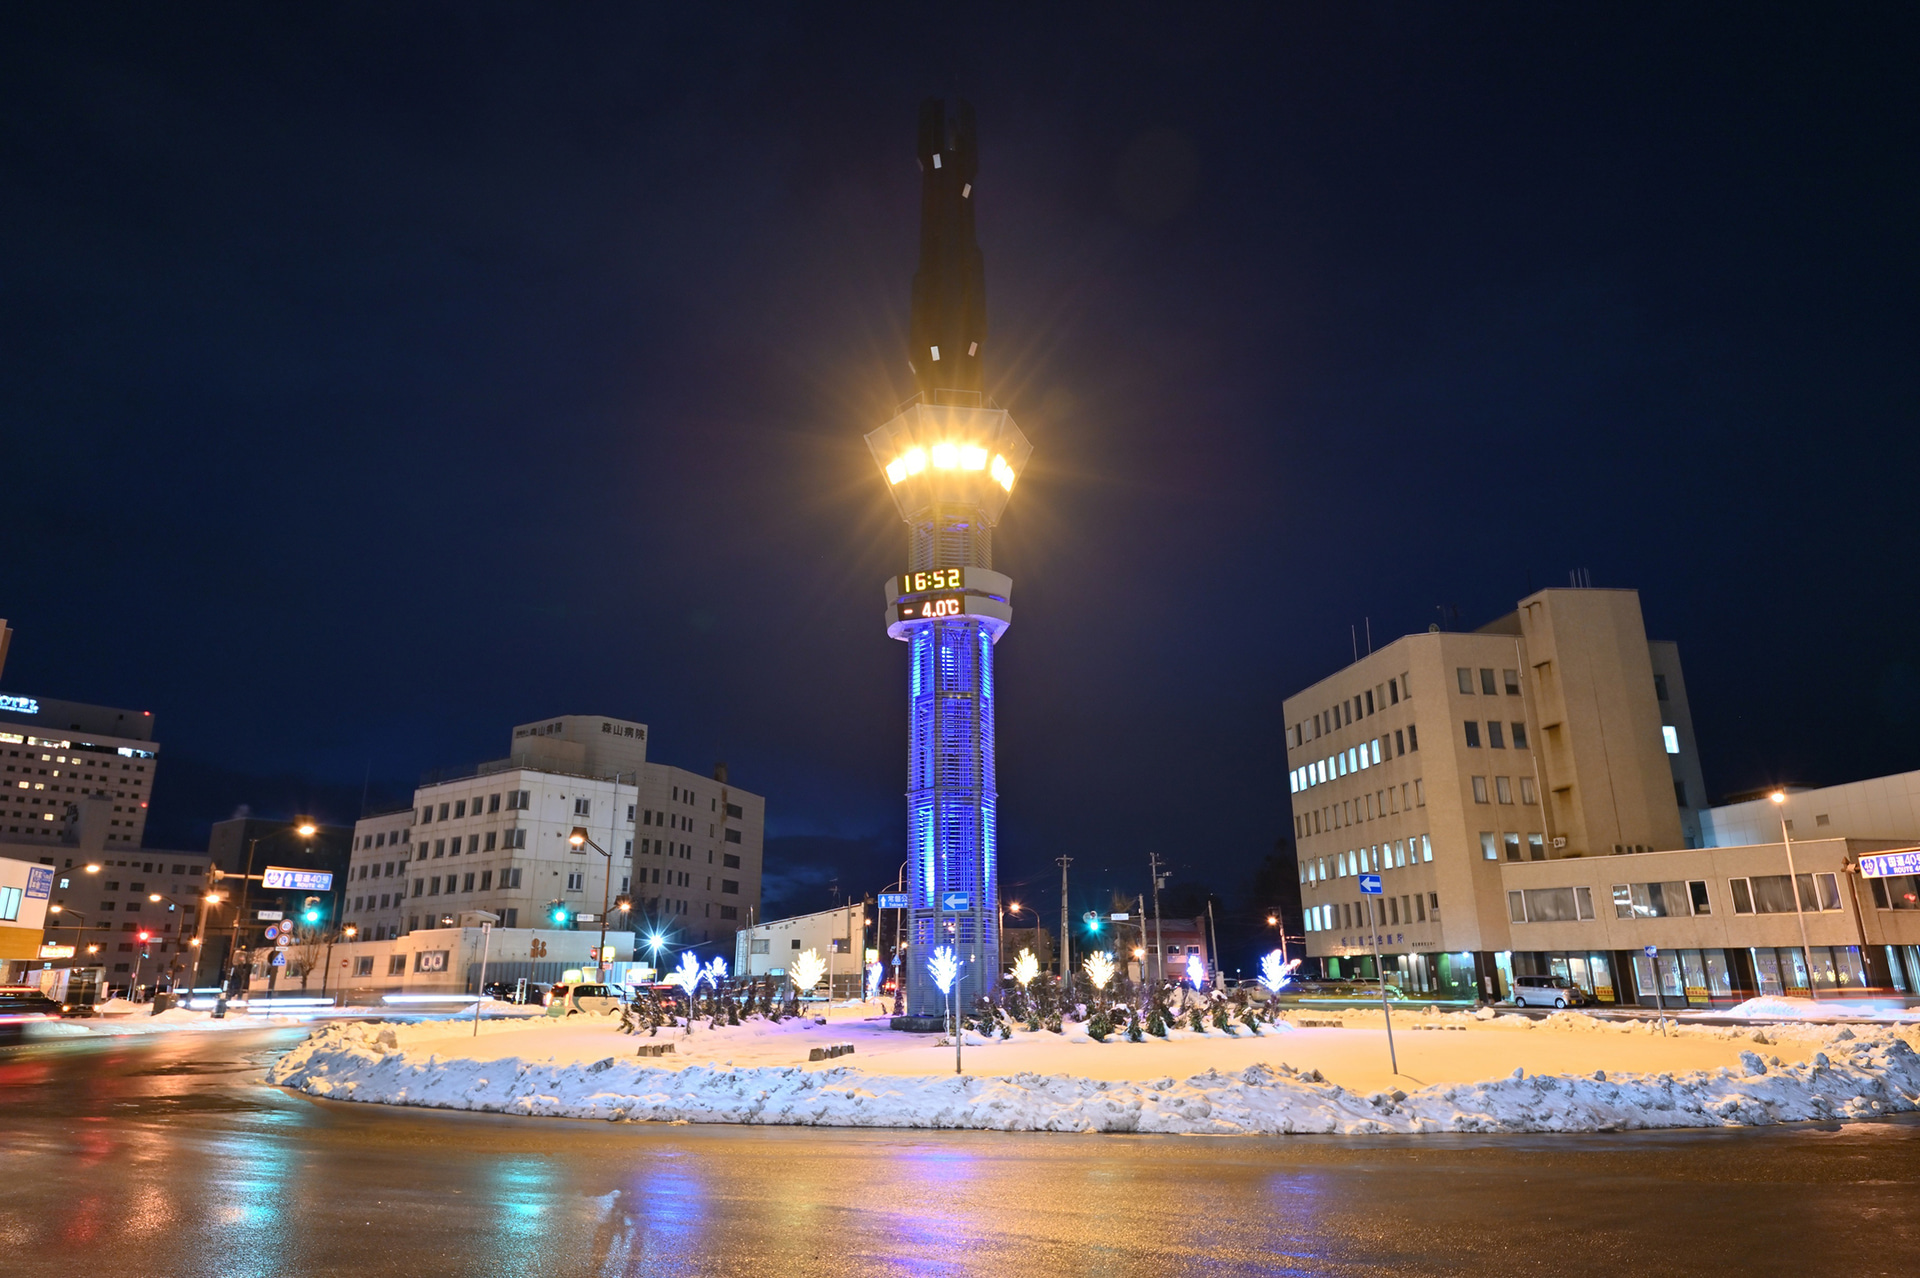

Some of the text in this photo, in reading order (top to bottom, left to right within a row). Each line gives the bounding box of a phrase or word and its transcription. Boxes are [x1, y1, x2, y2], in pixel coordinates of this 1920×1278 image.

[905, 569, 960, 593] 16:52
[602, 722, 645, 740] 森山病院
[294, 873, 330, 884] 国道40号
